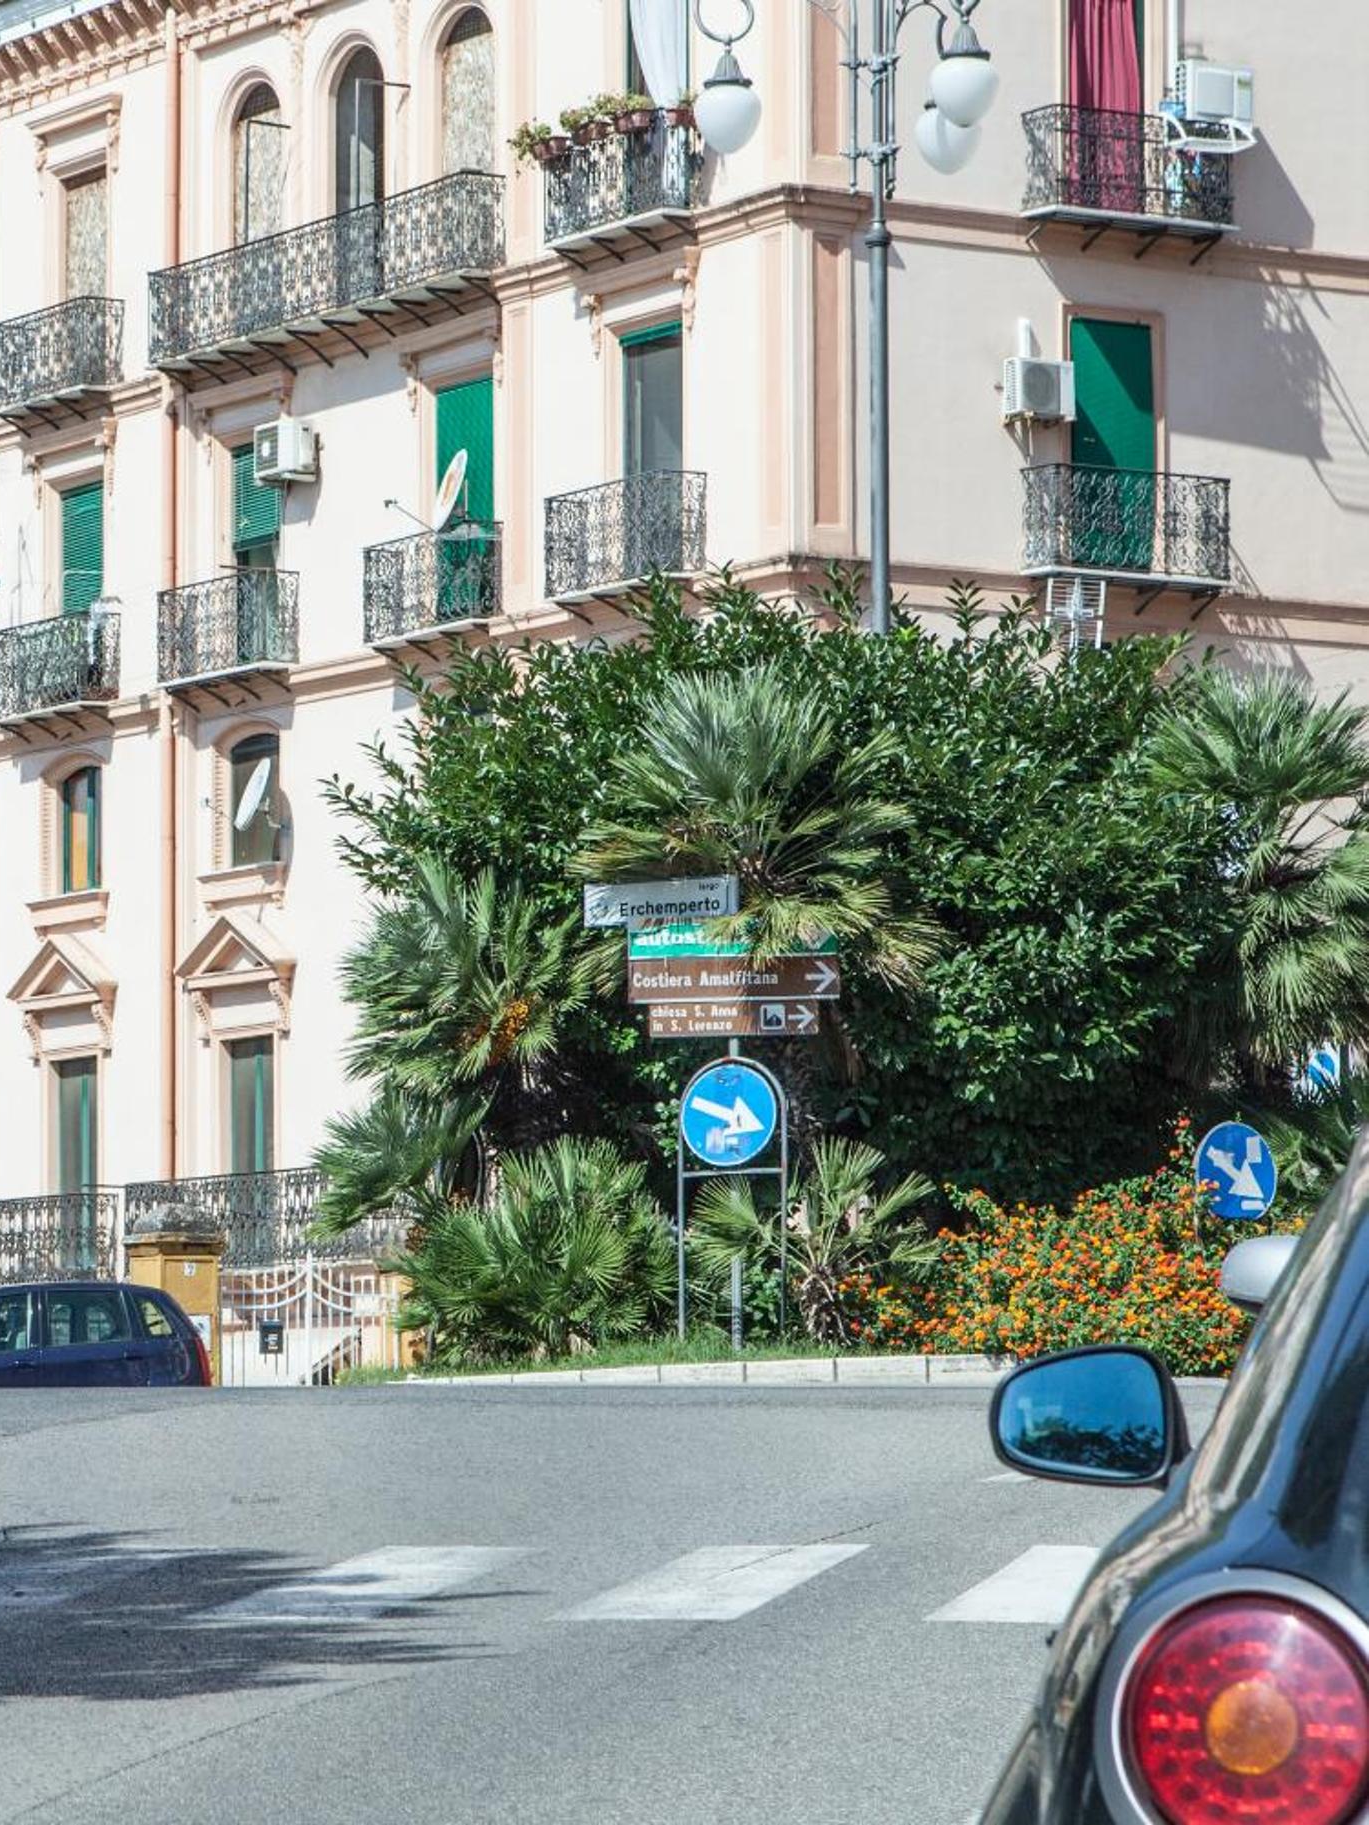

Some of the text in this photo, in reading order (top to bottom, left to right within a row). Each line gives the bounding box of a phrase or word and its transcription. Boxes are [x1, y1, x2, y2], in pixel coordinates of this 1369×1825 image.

[619, 897, 721, 917] Erchemperto
[632, 969, 779, 988] Costiera Amalfitana
[651, 1005, 688, 1018] chiesa
[652, 1019, 733, 1032] in S. Lorenzo
